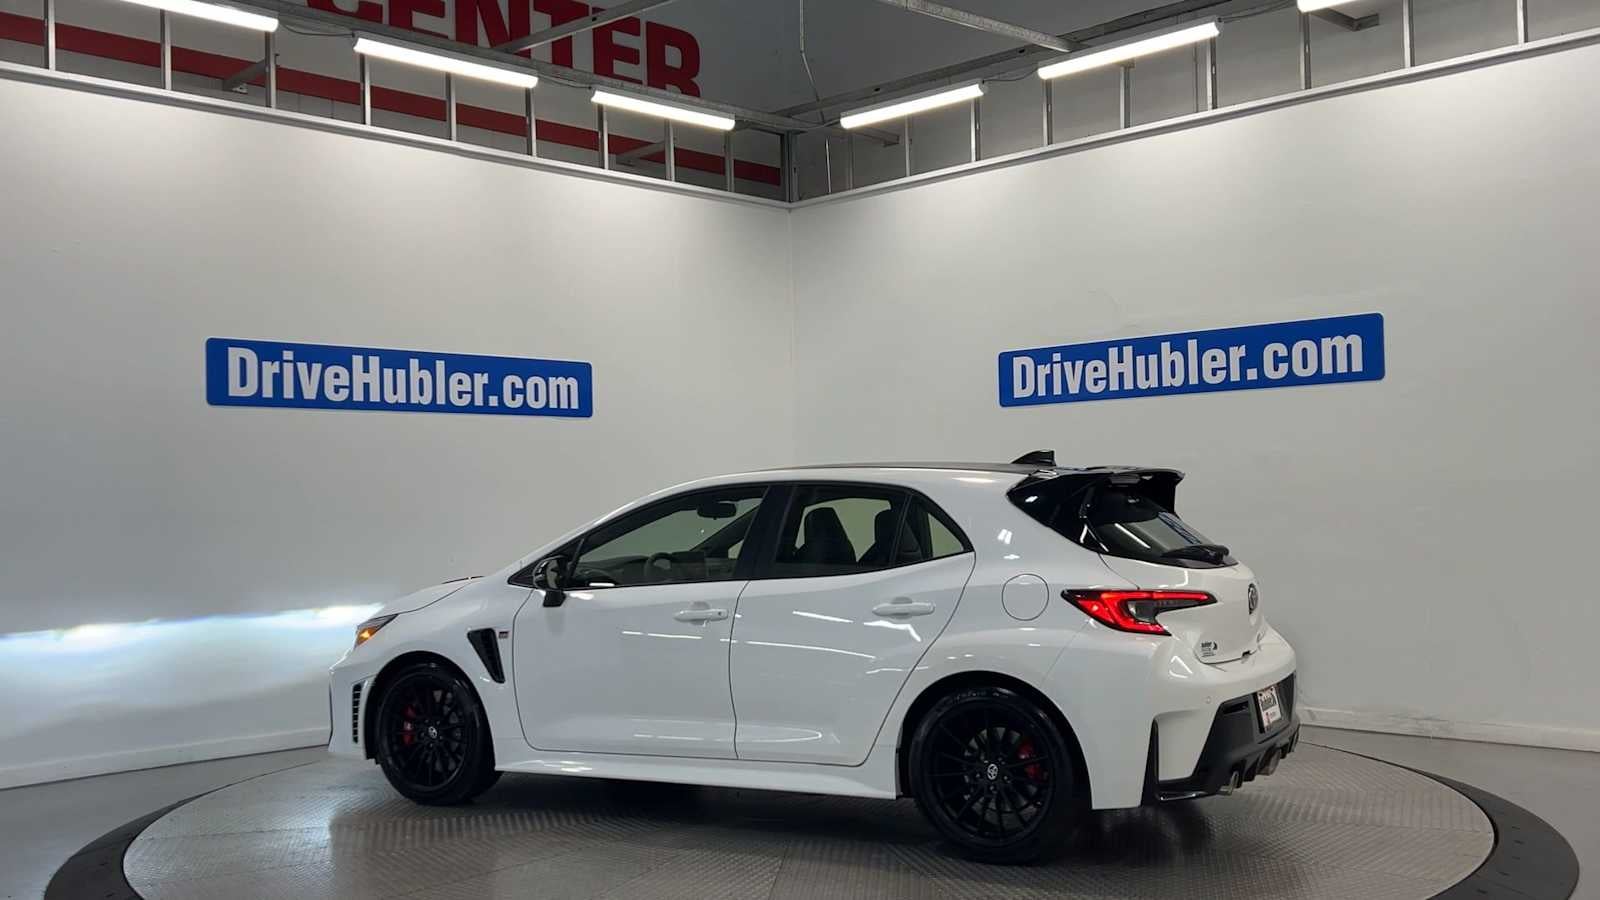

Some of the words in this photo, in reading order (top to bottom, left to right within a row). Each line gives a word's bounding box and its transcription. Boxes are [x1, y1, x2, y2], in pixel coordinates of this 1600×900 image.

[306, 0, 700, 98] NTER
[227, 346, 580, 410] DriveHubler.com
[1011, 333, 1364, 399] DriveHubler.com
